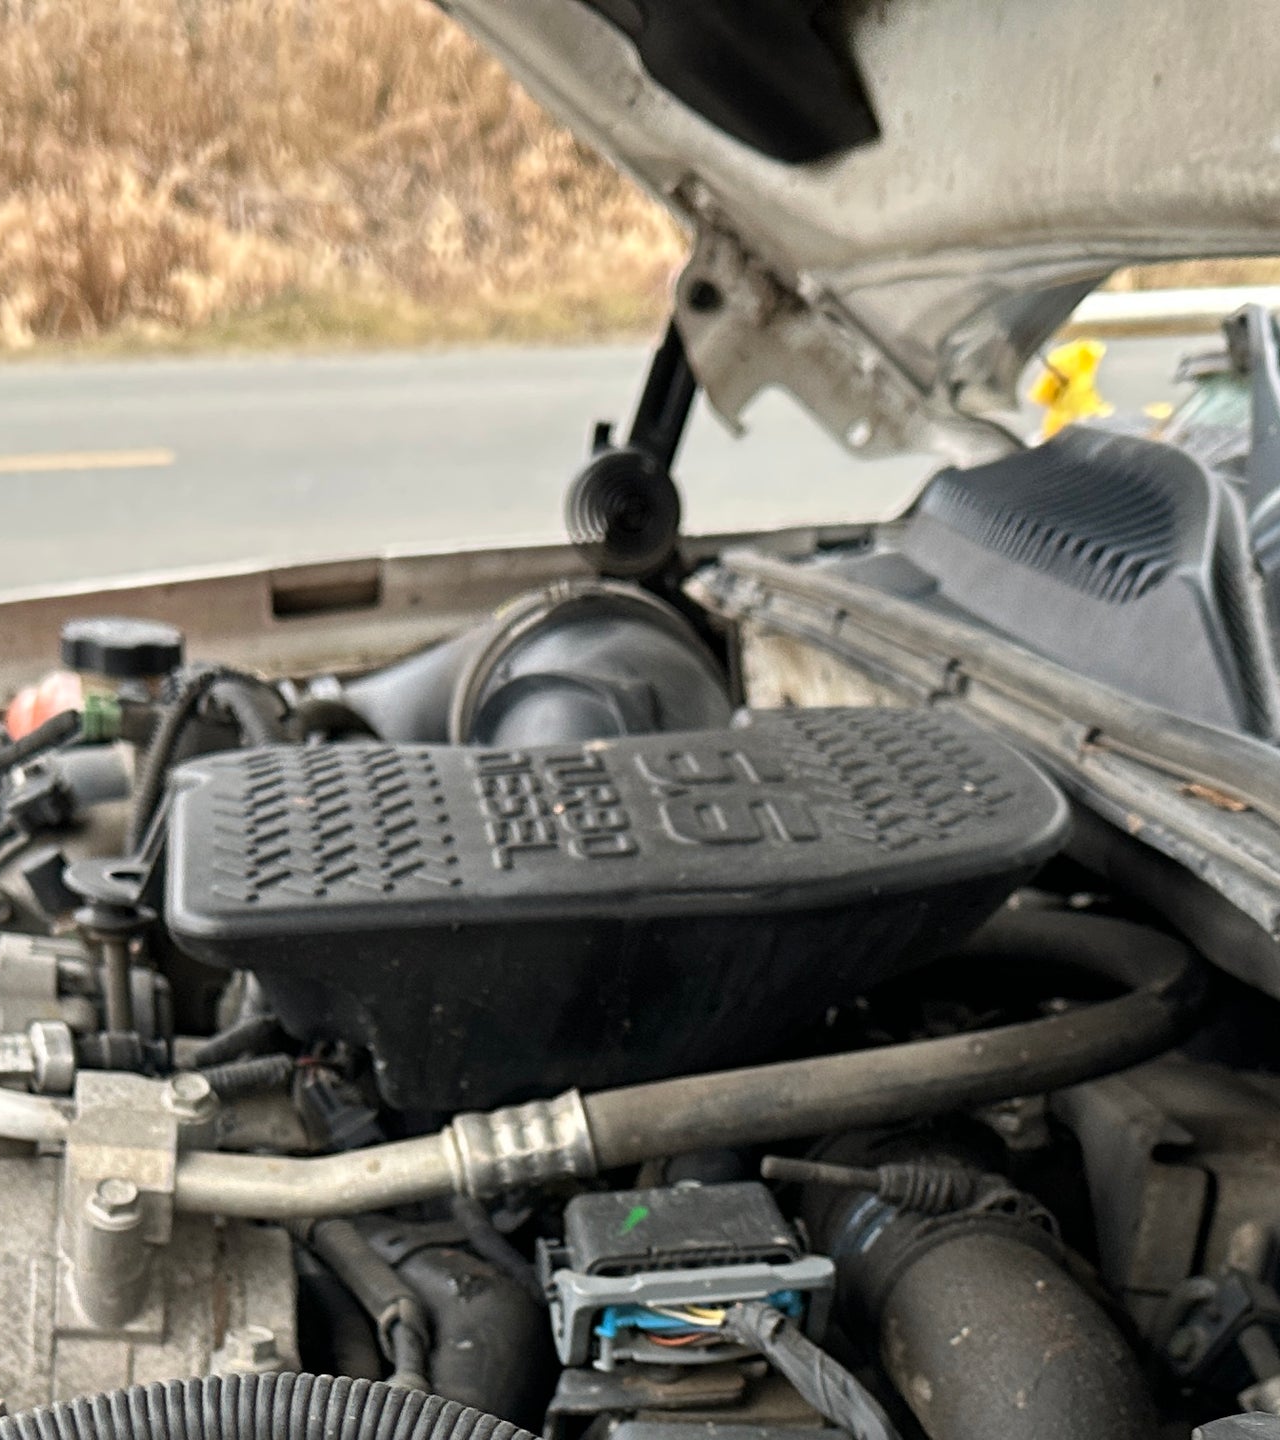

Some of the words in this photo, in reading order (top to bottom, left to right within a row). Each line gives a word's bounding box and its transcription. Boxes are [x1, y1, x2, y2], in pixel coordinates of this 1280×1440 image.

[465, 752, 558, 870] DIESEL
[543, 749, 639, 860] TURBO
[633, 750, 821, 846] 6.6
